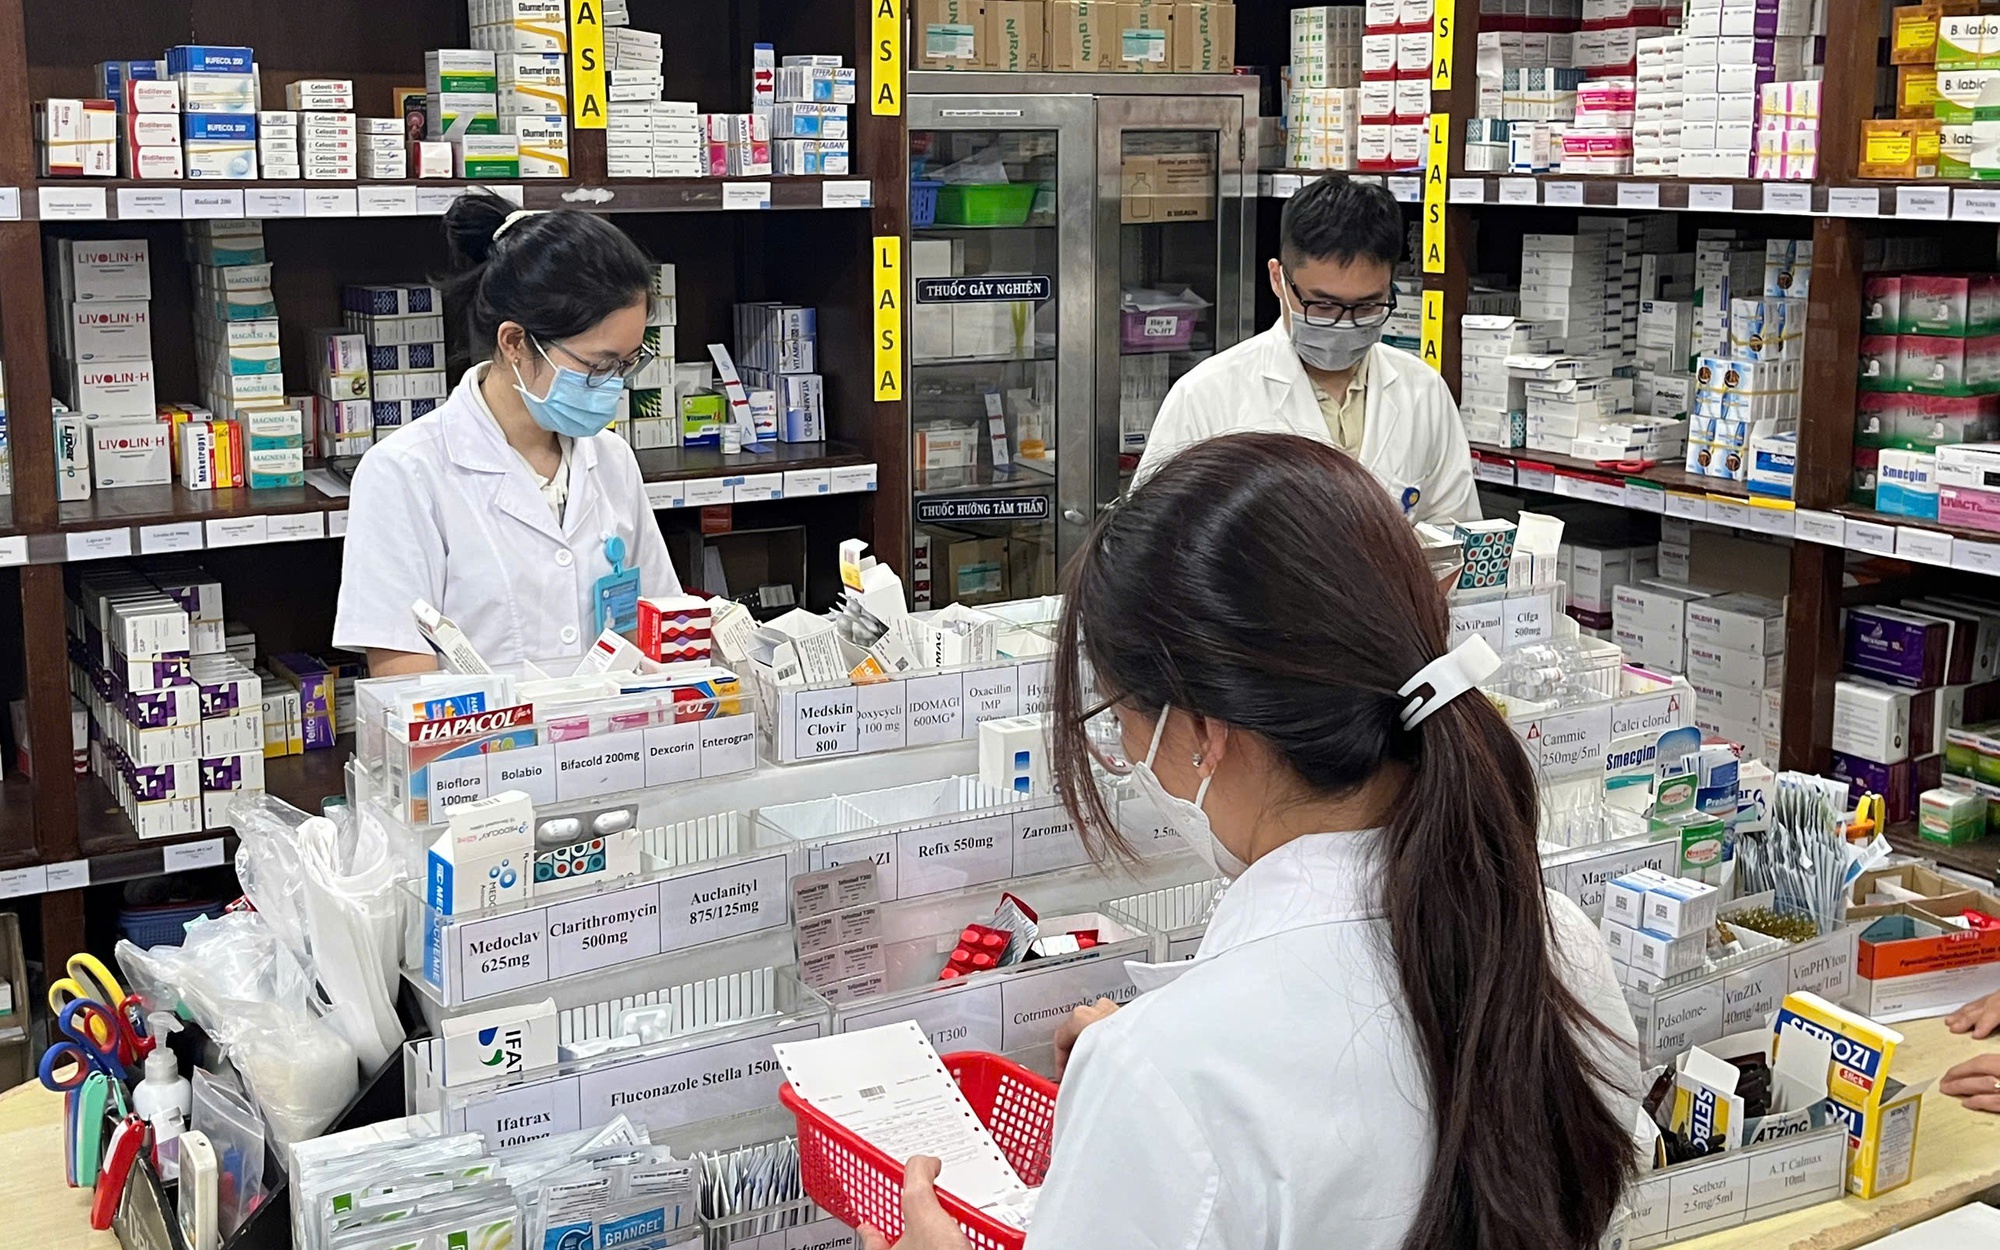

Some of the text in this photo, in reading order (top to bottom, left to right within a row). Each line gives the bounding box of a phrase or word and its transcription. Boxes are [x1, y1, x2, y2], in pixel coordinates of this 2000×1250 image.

[520, 66, 560, 74] Glumeform
[206, 124, 233, 132] BUFECOL
[522, 129, 562, 137] Glumeform
[926, 279, 1041, 297] THUỐC GÂY NGHIỆN
[879, 248, 896, 391] LASA
[1883, 465, 1927, 482] Smecgim
[922, 501, 955, 517] THUỐC
[993, 501, 1014, 514] TÂM
[1455, 617, 1500, 632] SaViPamol
[1517, 612, 1538, 623] Cifga
[1514, 626, 1541, 638] 500mg
[970, 684, 1012, 698] Oxacillin
[801, 703, 853, 720] Medskin
[981, 700, 1001, 710] IMP
[418, 713, 514, 741] HAPACOL
[807, 722, 846, 736] Clovir
[865, 723, 900, 735] 100 mg
[1613, 713, 1671, 733] Calci clorid
[702, 732, 754, 748] Enterogran
[816, 739, 838, 752] 800
[1542, 729, 1586, 746] Cammic
[650, 742, 694, 757] Dexcorin
[1541, 743, 1601, 766] 250mg/5ml
[1606, 745, 1655, 771] Smecgim
[561, 750, 640, 771] Bifacold 200mg
[501, 766, 542, 781] Bolabio
[436, 776, 480, 790] Bioflora
[441, 793, 478, 806] 100mg
[1022, 822, 1074, 839] Zaromax
[918, 836, 994, 859] Refix 550mg
[1582, 865, 1628, 886] Magnesi
[690, 879, 757, 905] Auclanityl
[550, 902, 657, 937] Clarithromycin
[690, 899, 759, 925] 875/125mg
[470, 931, 540, 956] Medoclav
[582, 931, 628, 950] 500mg
[481, 954, 530, 973] 625mg
[1793, 953, 1847, 980] VinPHYton
[1726, 981, 1762, 1005] VinZIX
[1724, 1000, 1772, 1027] 40mg/4ml
[937, 1026, 967, 1043] T300
[1656, 1033, 1685, 1050] 40mg
[611, 1059, 781, 1107] Fluconazole Stella 150m
[496, 1112, 551, 1132] Ifatrax
[1769, 1154, 1822, 1176] A.T Calmax
[1692, 1178, 1726, 1195] Setbozi
[1783, 1173, 1806, 1188] 10ml
[1684, 1191, 1733, 1214] 2.5mg/5ml
[605, 1221, 659, 1246] GRANGEL
